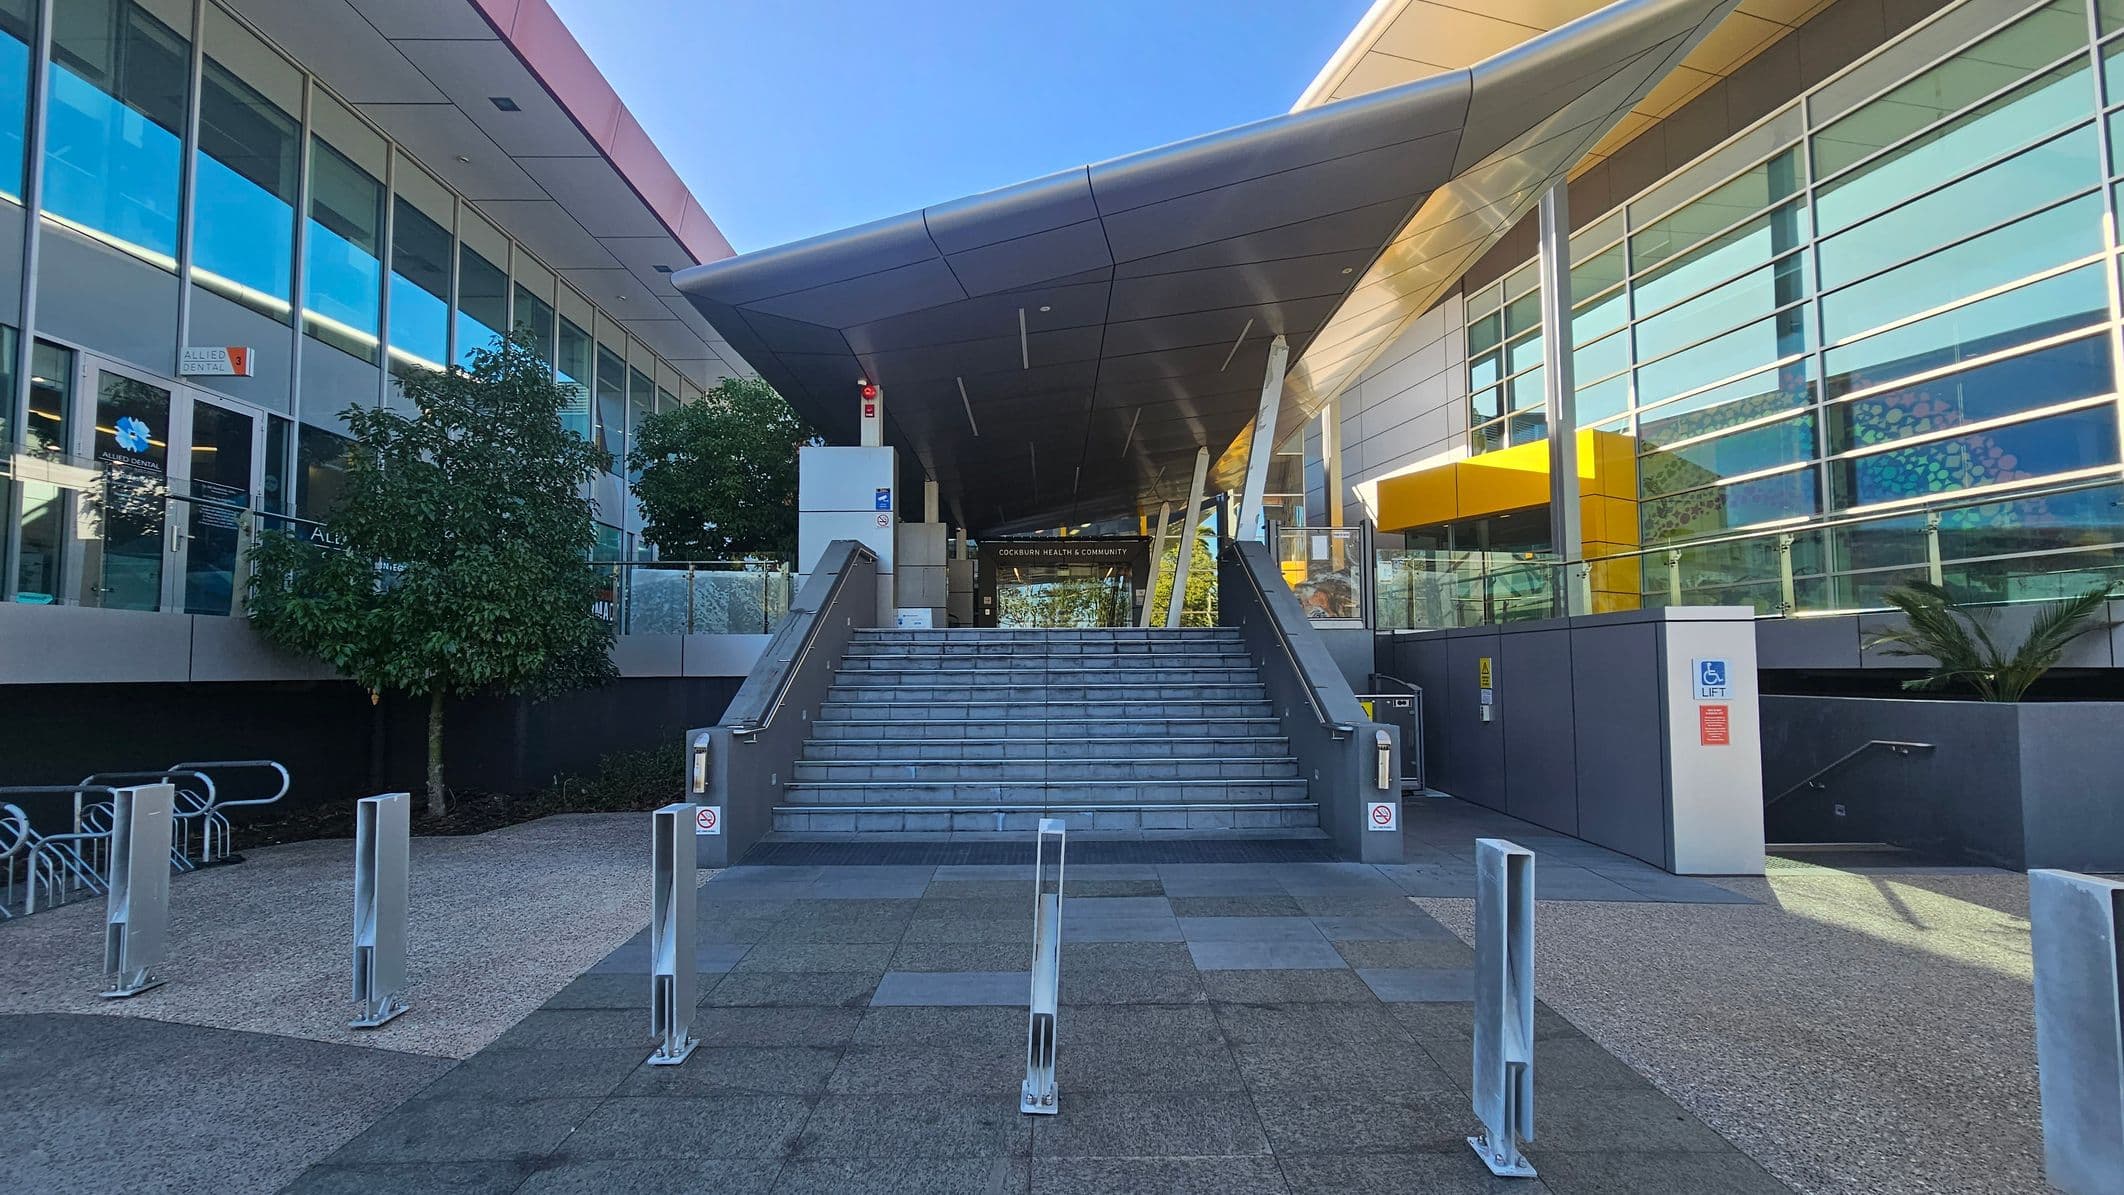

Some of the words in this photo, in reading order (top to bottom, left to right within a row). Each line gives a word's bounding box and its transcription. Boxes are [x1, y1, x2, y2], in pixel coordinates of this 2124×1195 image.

[184, 350, 226, 360] ALLIED
[235, 356, 242, 366] 3
[183, 363, 225, 372] DENTAL
[102, 451, 129, 462] ALLIED
[131, 458, 161, 470] DENTAL
[1081, 548, 1128, 556] COMMUNITY
[1701, 687, 1726, 698] LIFT
